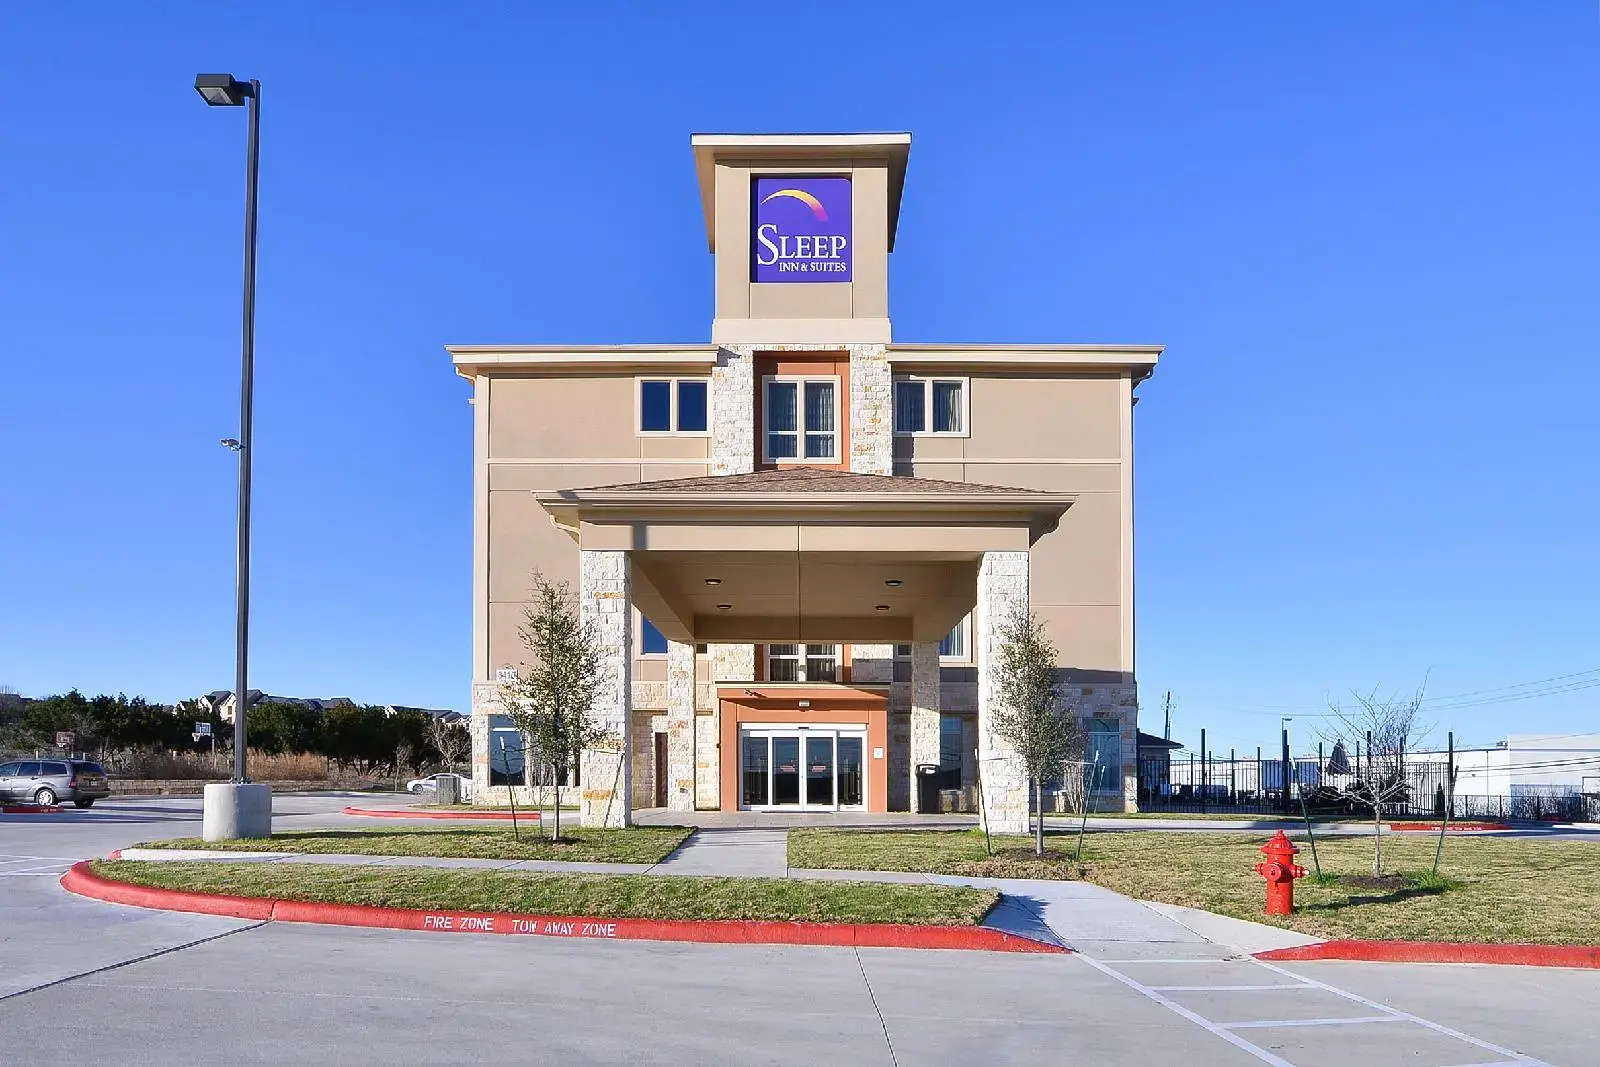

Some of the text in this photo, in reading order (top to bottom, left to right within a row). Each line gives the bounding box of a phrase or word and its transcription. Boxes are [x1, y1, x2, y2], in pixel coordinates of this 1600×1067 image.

[757, 223, 847, 265] SLEEP
[779, 262, 847, 272] INN & SUITES
[424, 916, 617, 937] FIRE ZONE TOW AWAY ZONE
